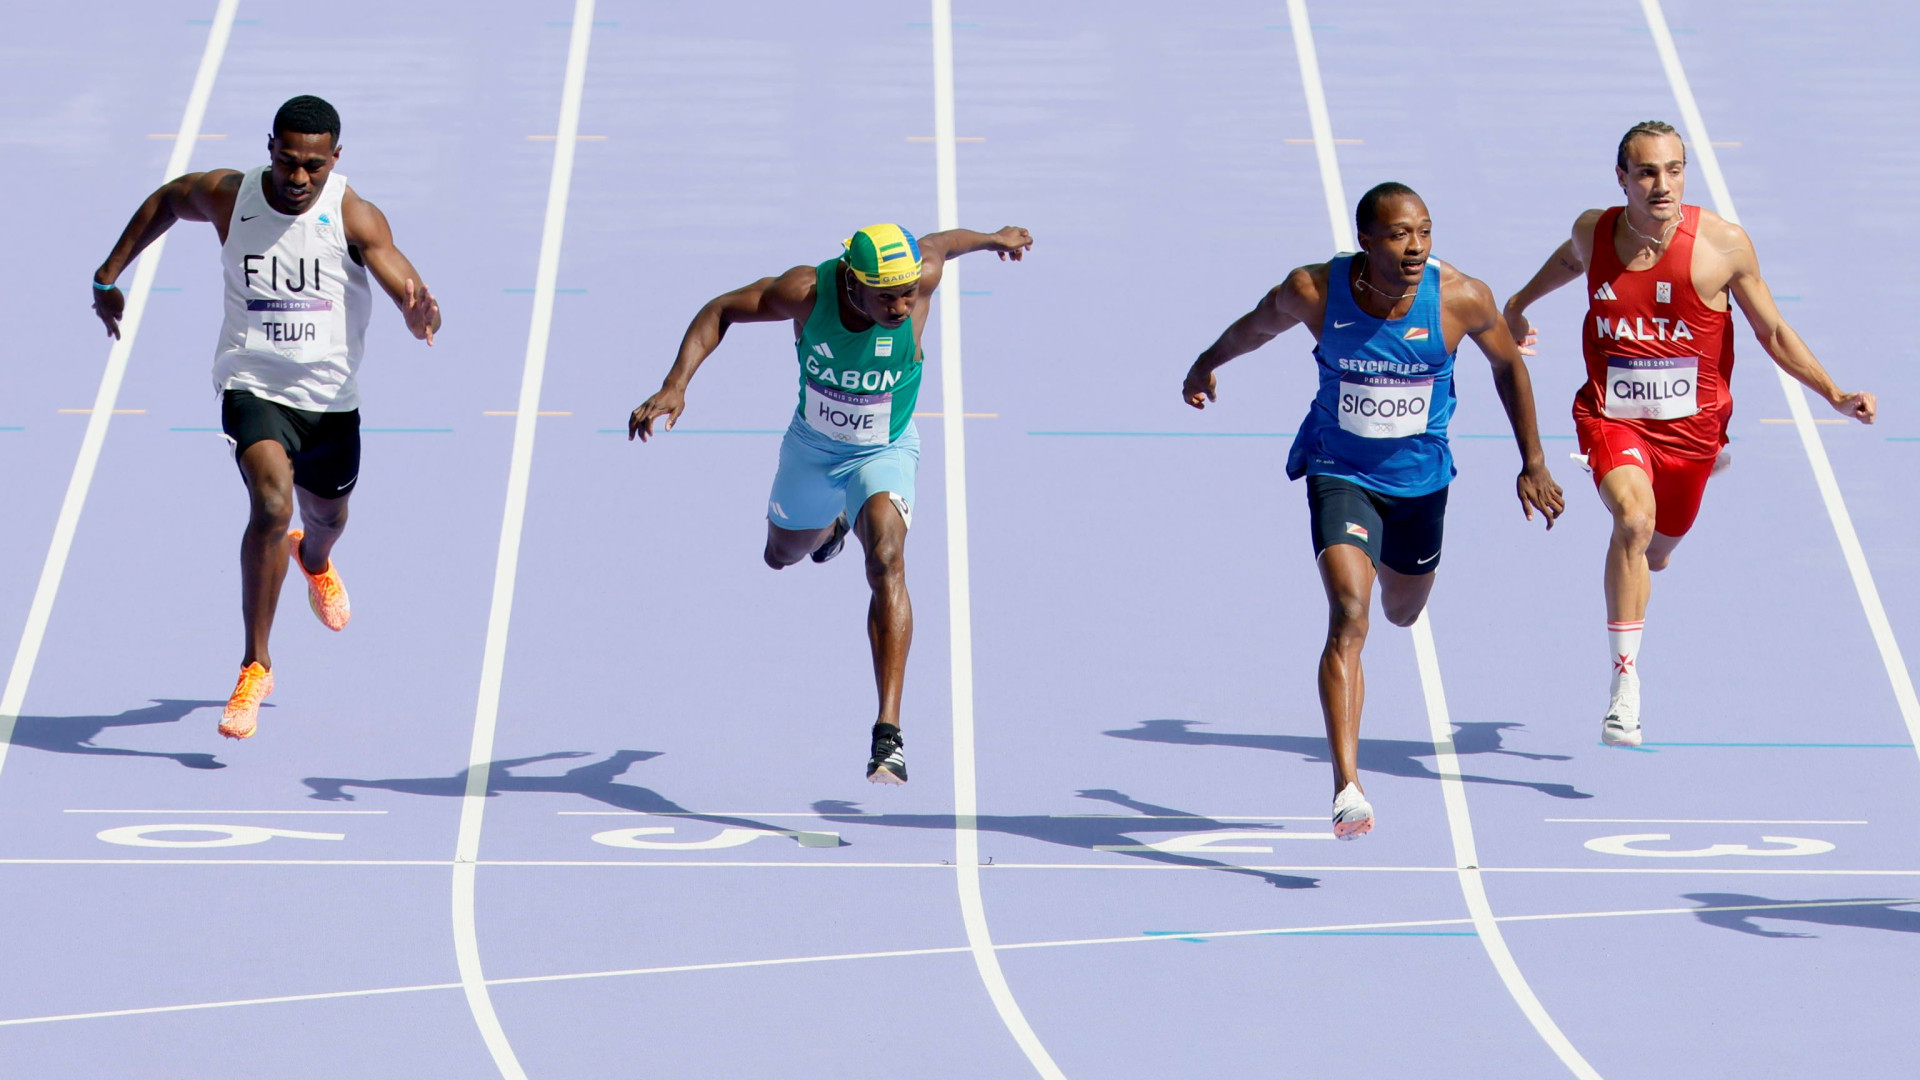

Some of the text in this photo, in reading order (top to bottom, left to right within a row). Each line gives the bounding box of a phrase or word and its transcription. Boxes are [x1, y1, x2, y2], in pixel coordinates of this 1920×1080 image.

[244, 254, 321, 293] FIJI
[882, 270, 916, 283] GABON
[266, 302, 311, 310] PARIS 2024
[262, 322, 316, 342] TEWA
[1595, 315, 1694, 342] MALTA
[805, 354, 903, 392] GABON
[1338, 357, 1430, 374] SEYCHELLES
[1628, 359, 1675, 368] PARIS 2024
[1364, 376, 1412, 386] PARIS 2024
[1613, 379, 1691, 401] GRILLO
[823, 389, 869, 405] PARIS 2024
[1342, 393, 1426, 419] SICOBO
[818, 401, 875, 431] HOYE
